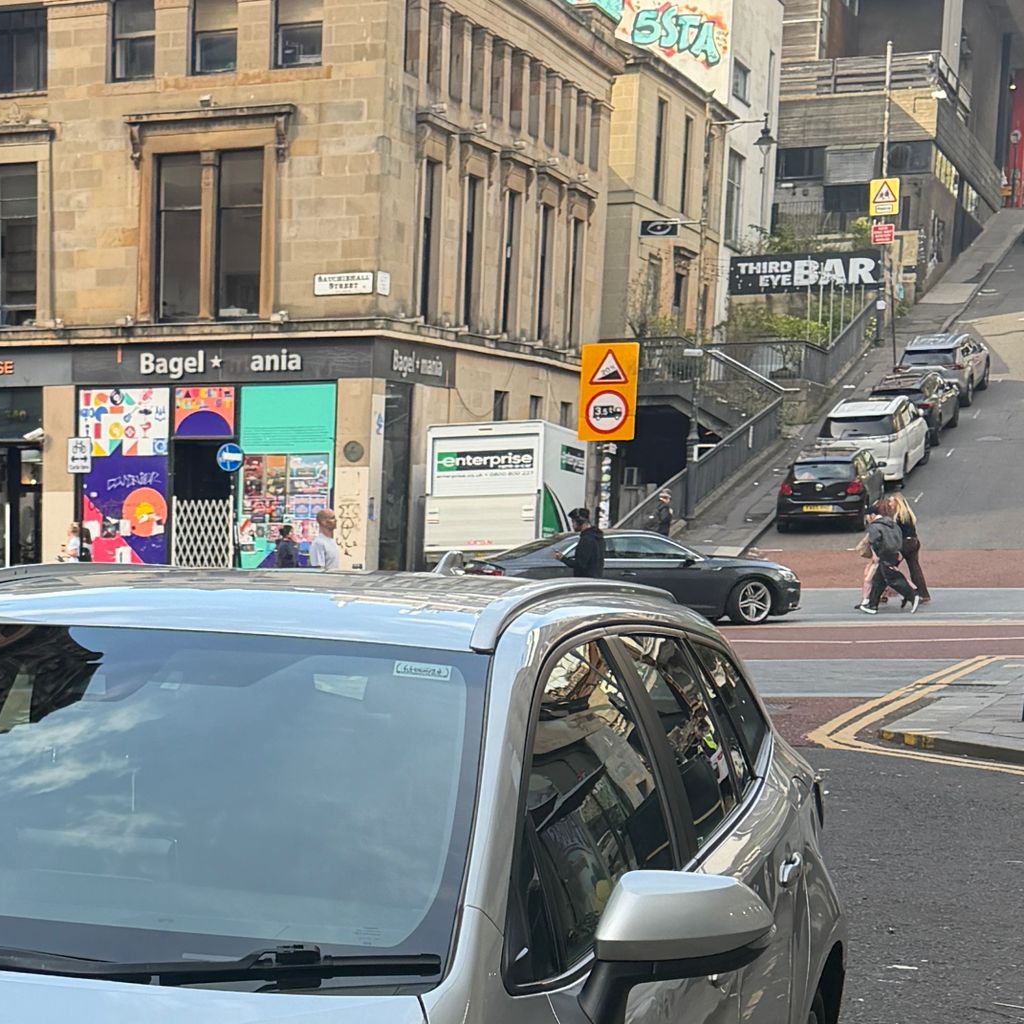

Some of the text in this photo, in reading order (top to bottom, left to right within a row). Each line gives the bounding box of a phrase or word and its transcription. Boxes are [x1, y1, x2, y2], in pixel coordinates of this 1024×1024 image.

[737, 260, 792, 274] THIRD
[793, 258, 876, 287] BAR
[759, 274, 792, 287] EYE
[139, 350, 205, 379] Bagel
[392, 349, 443, 378] Bagel mania
[437, 452, 533, 468] enterprise
